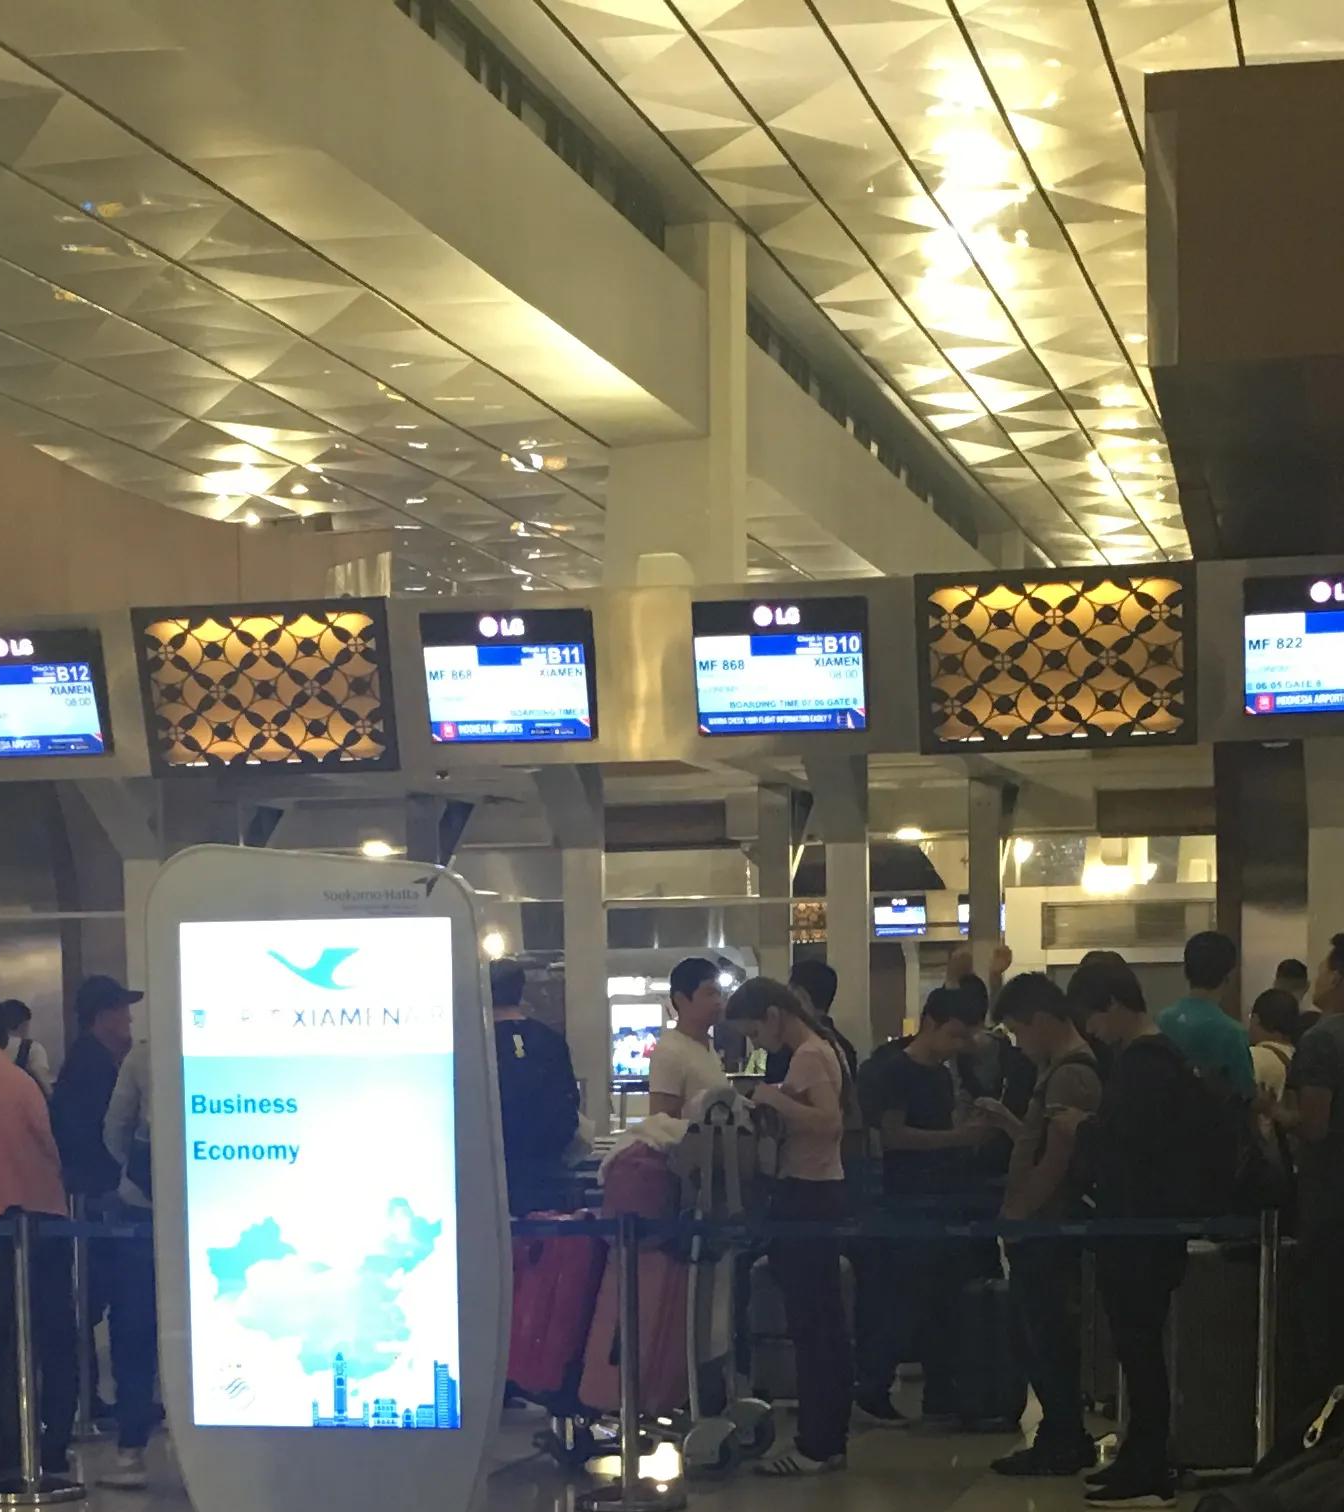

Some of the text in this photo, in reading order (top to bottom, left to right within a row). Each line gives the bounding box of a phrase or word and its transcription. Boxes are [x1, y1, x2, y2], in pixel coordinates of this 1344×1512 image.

[776, 607, 800, 625] LG
[500, 617, 525, 636] LG
[10, 639, 34, 656] LG
[824, 636, 860, 653] B10
[1249, 637, 1303, 650] MF 822
[548, 647, 580, 664] B11
[815, 657, 860, 667] XIAMEN
[540, 668, 582, 677] XIAMEN
[699, 660, 744, 671] MF 868
[56, 666, 90, 681] B12
[429, 671, 445, 681] MF
[50, 685, 91, 695] XIAMEN
[510, 709, 555, 717] BOARNG
[191, 1094, 298, 1115] Business
[193, 1141, 300, 1164] Economy
